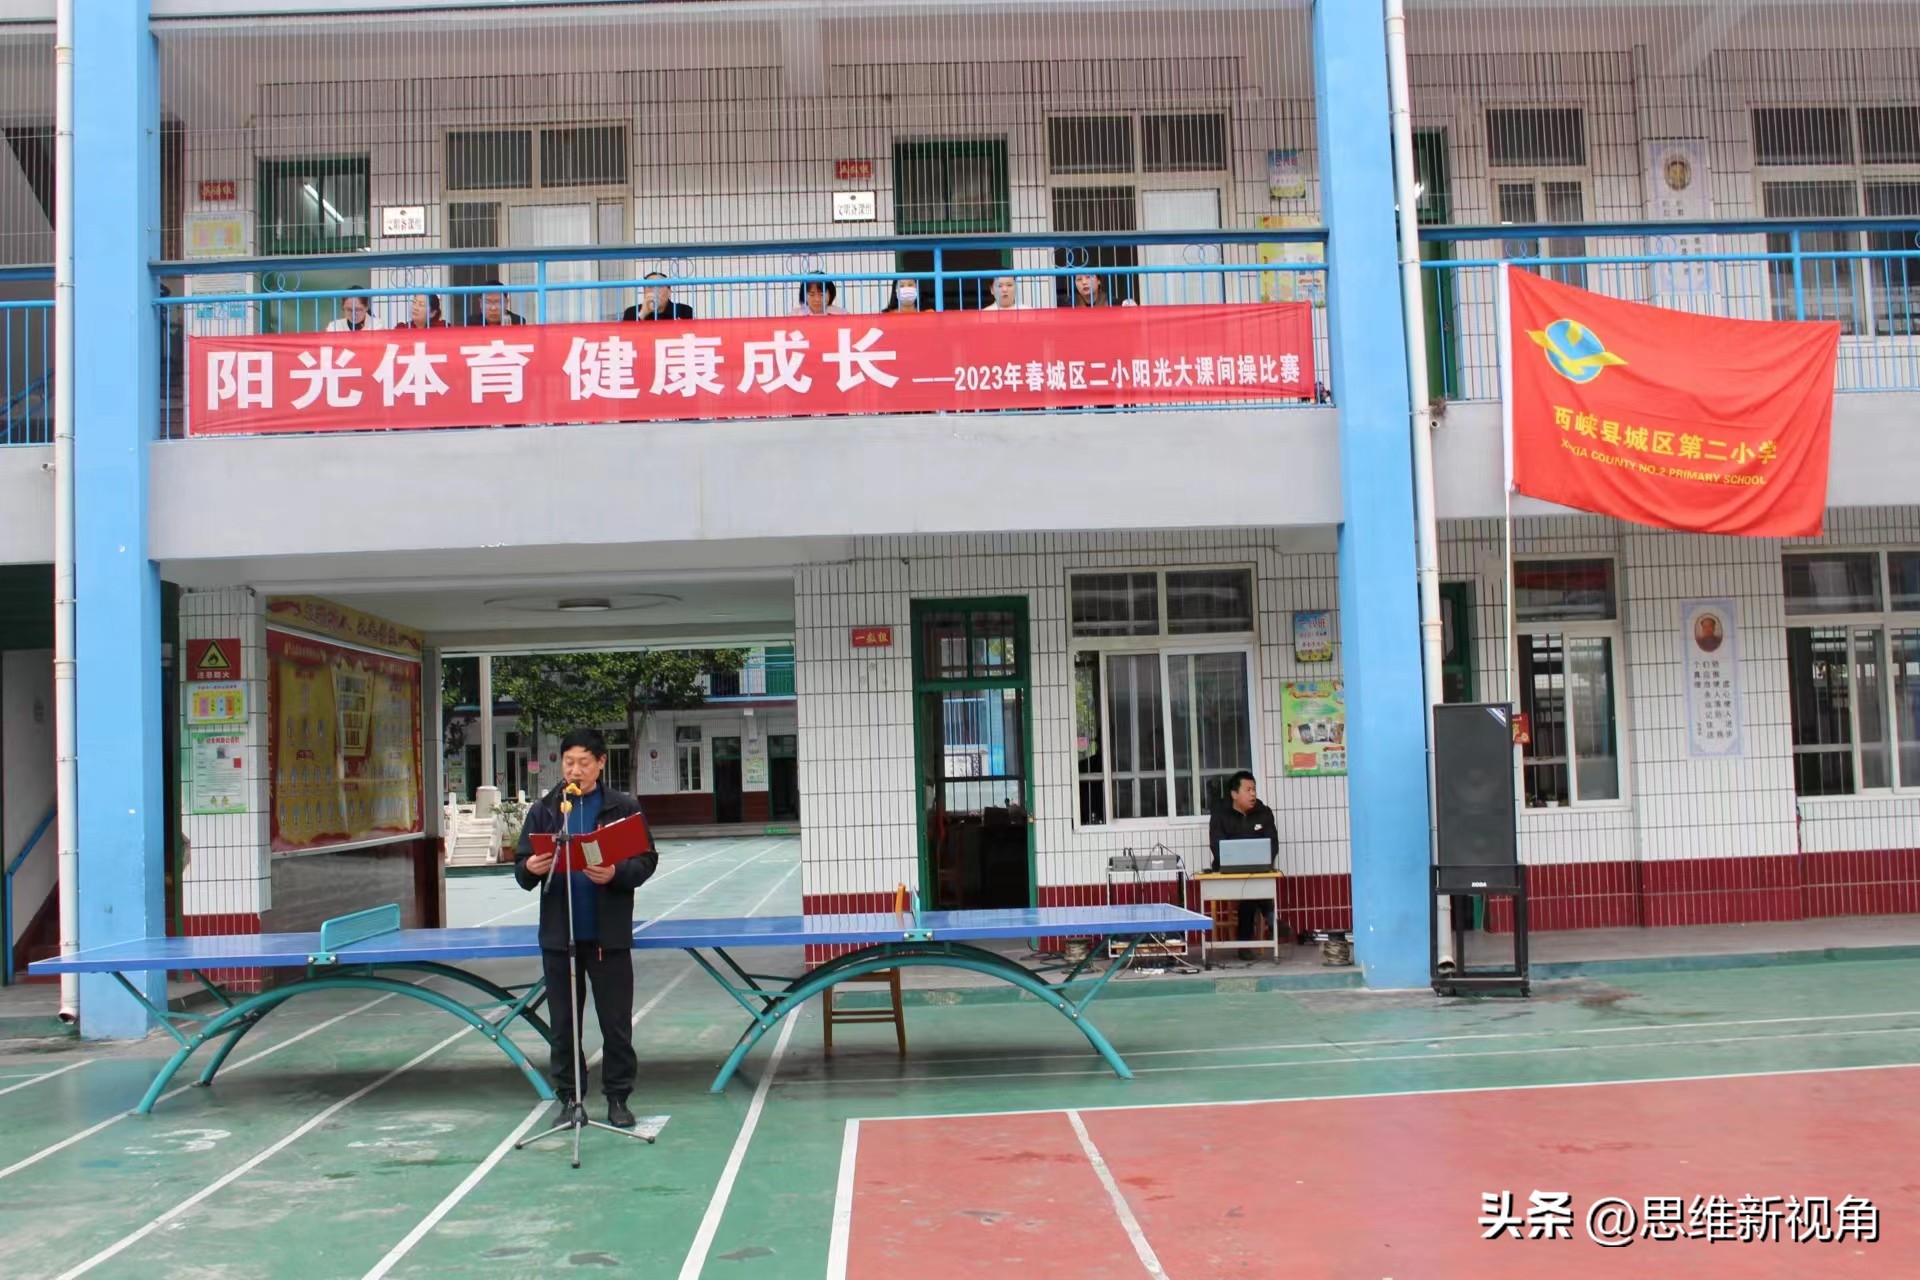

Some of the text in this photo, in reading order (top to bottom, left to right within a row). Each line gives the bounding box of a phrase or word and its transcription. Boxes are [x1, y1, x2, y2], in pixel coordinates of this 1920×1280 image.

[206, 338, 535, 410] 阳光体育
[561, 328, 904, 400] 健康成长
[1553, 404, 1777, 465] 西峡县城区第二小学
[1591, 450, 1635, 472] COUNTY
[1638, 463, 1666, 477] NO.2
[1668, 467, 1721, 483] PRIMARY
[1723, 475, 1768, 486] SCHOOL
[197, 671, 230, 679] 注意防火
